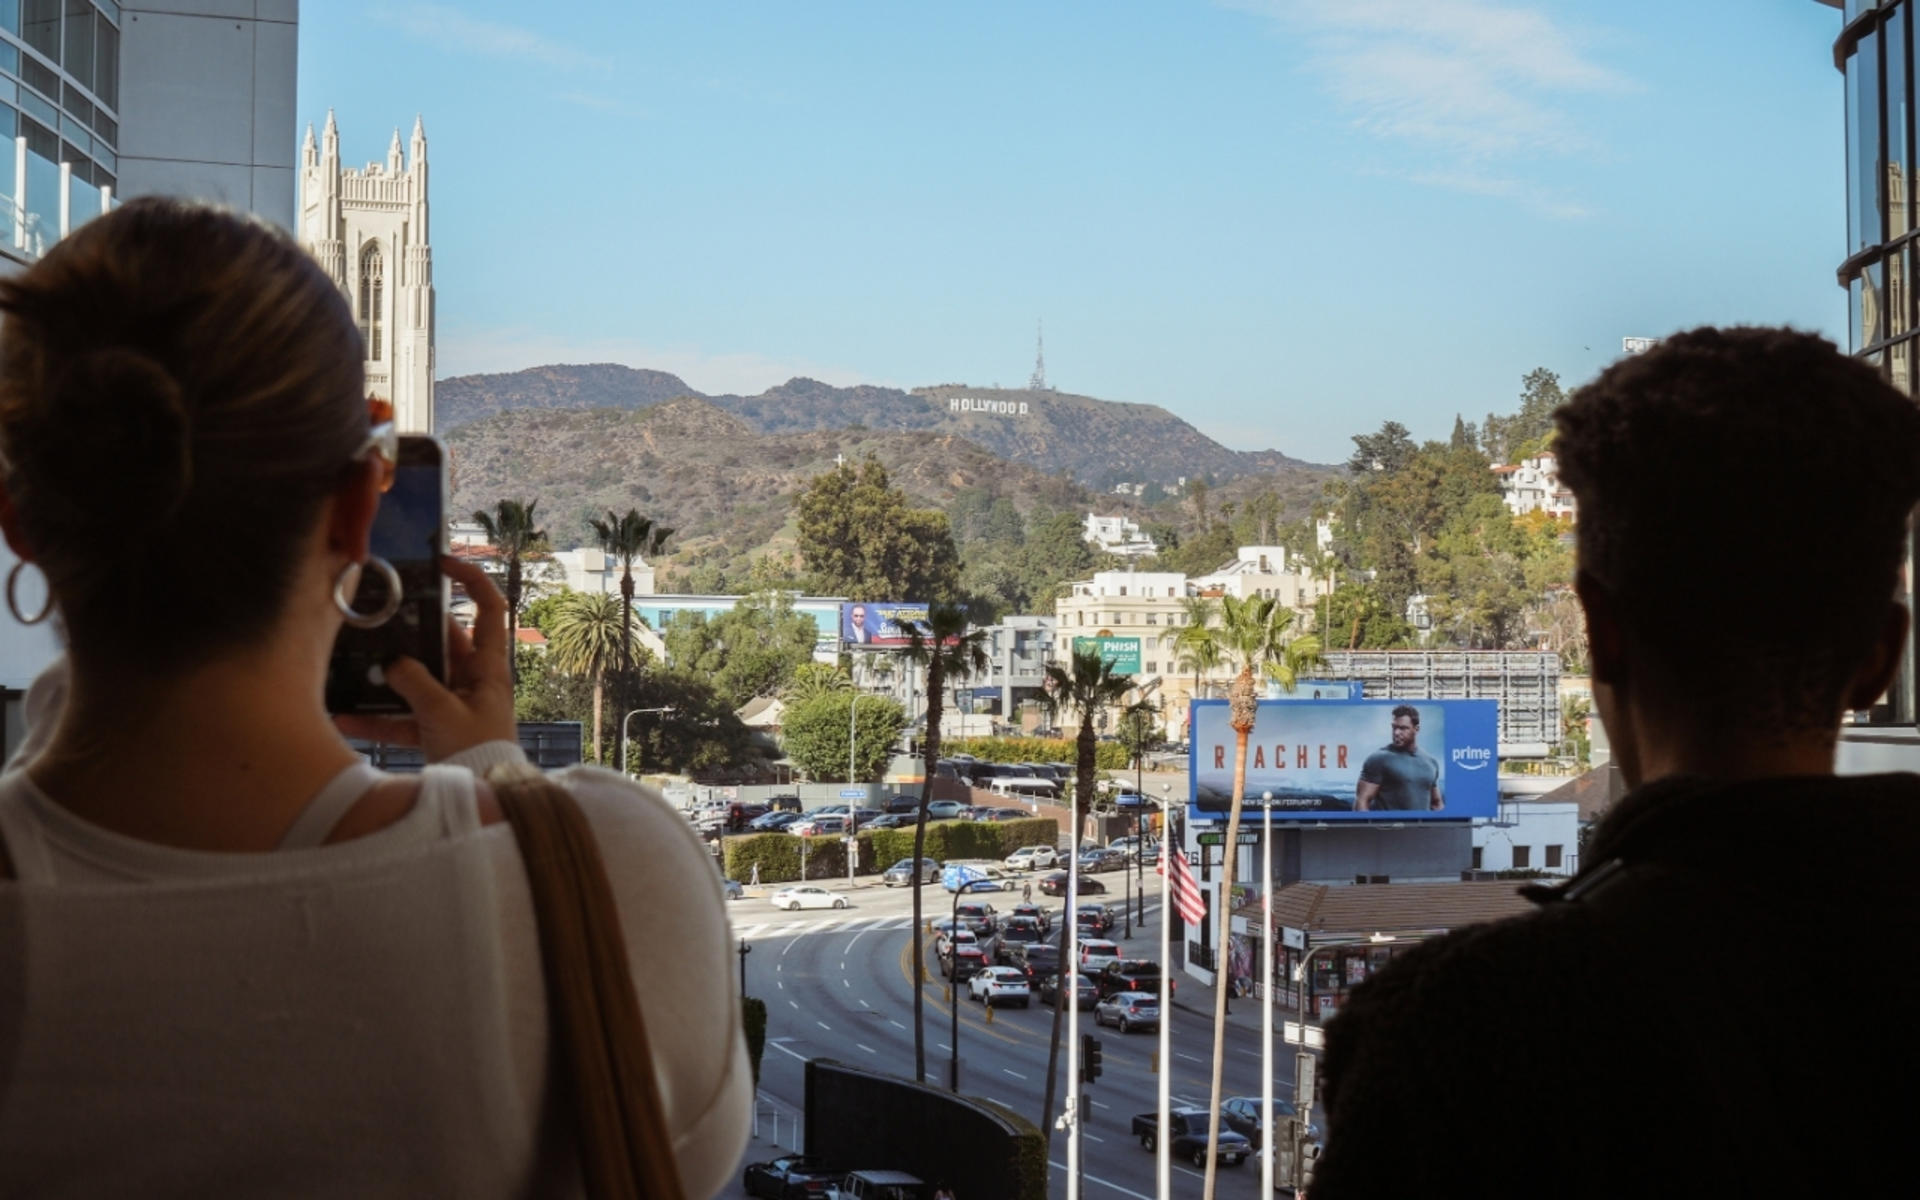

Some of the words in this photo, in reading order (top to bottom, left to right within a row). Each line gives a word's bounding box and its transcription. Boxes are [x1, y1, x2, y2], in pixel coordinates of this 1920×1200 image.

[950, 399, 1028, 414] HOLLYWOOD
[1104, 641, 1138, 652] PHISH
[1214, 744, 1348, 769] RACHER
[1453, 746, 1491, 761] prime
